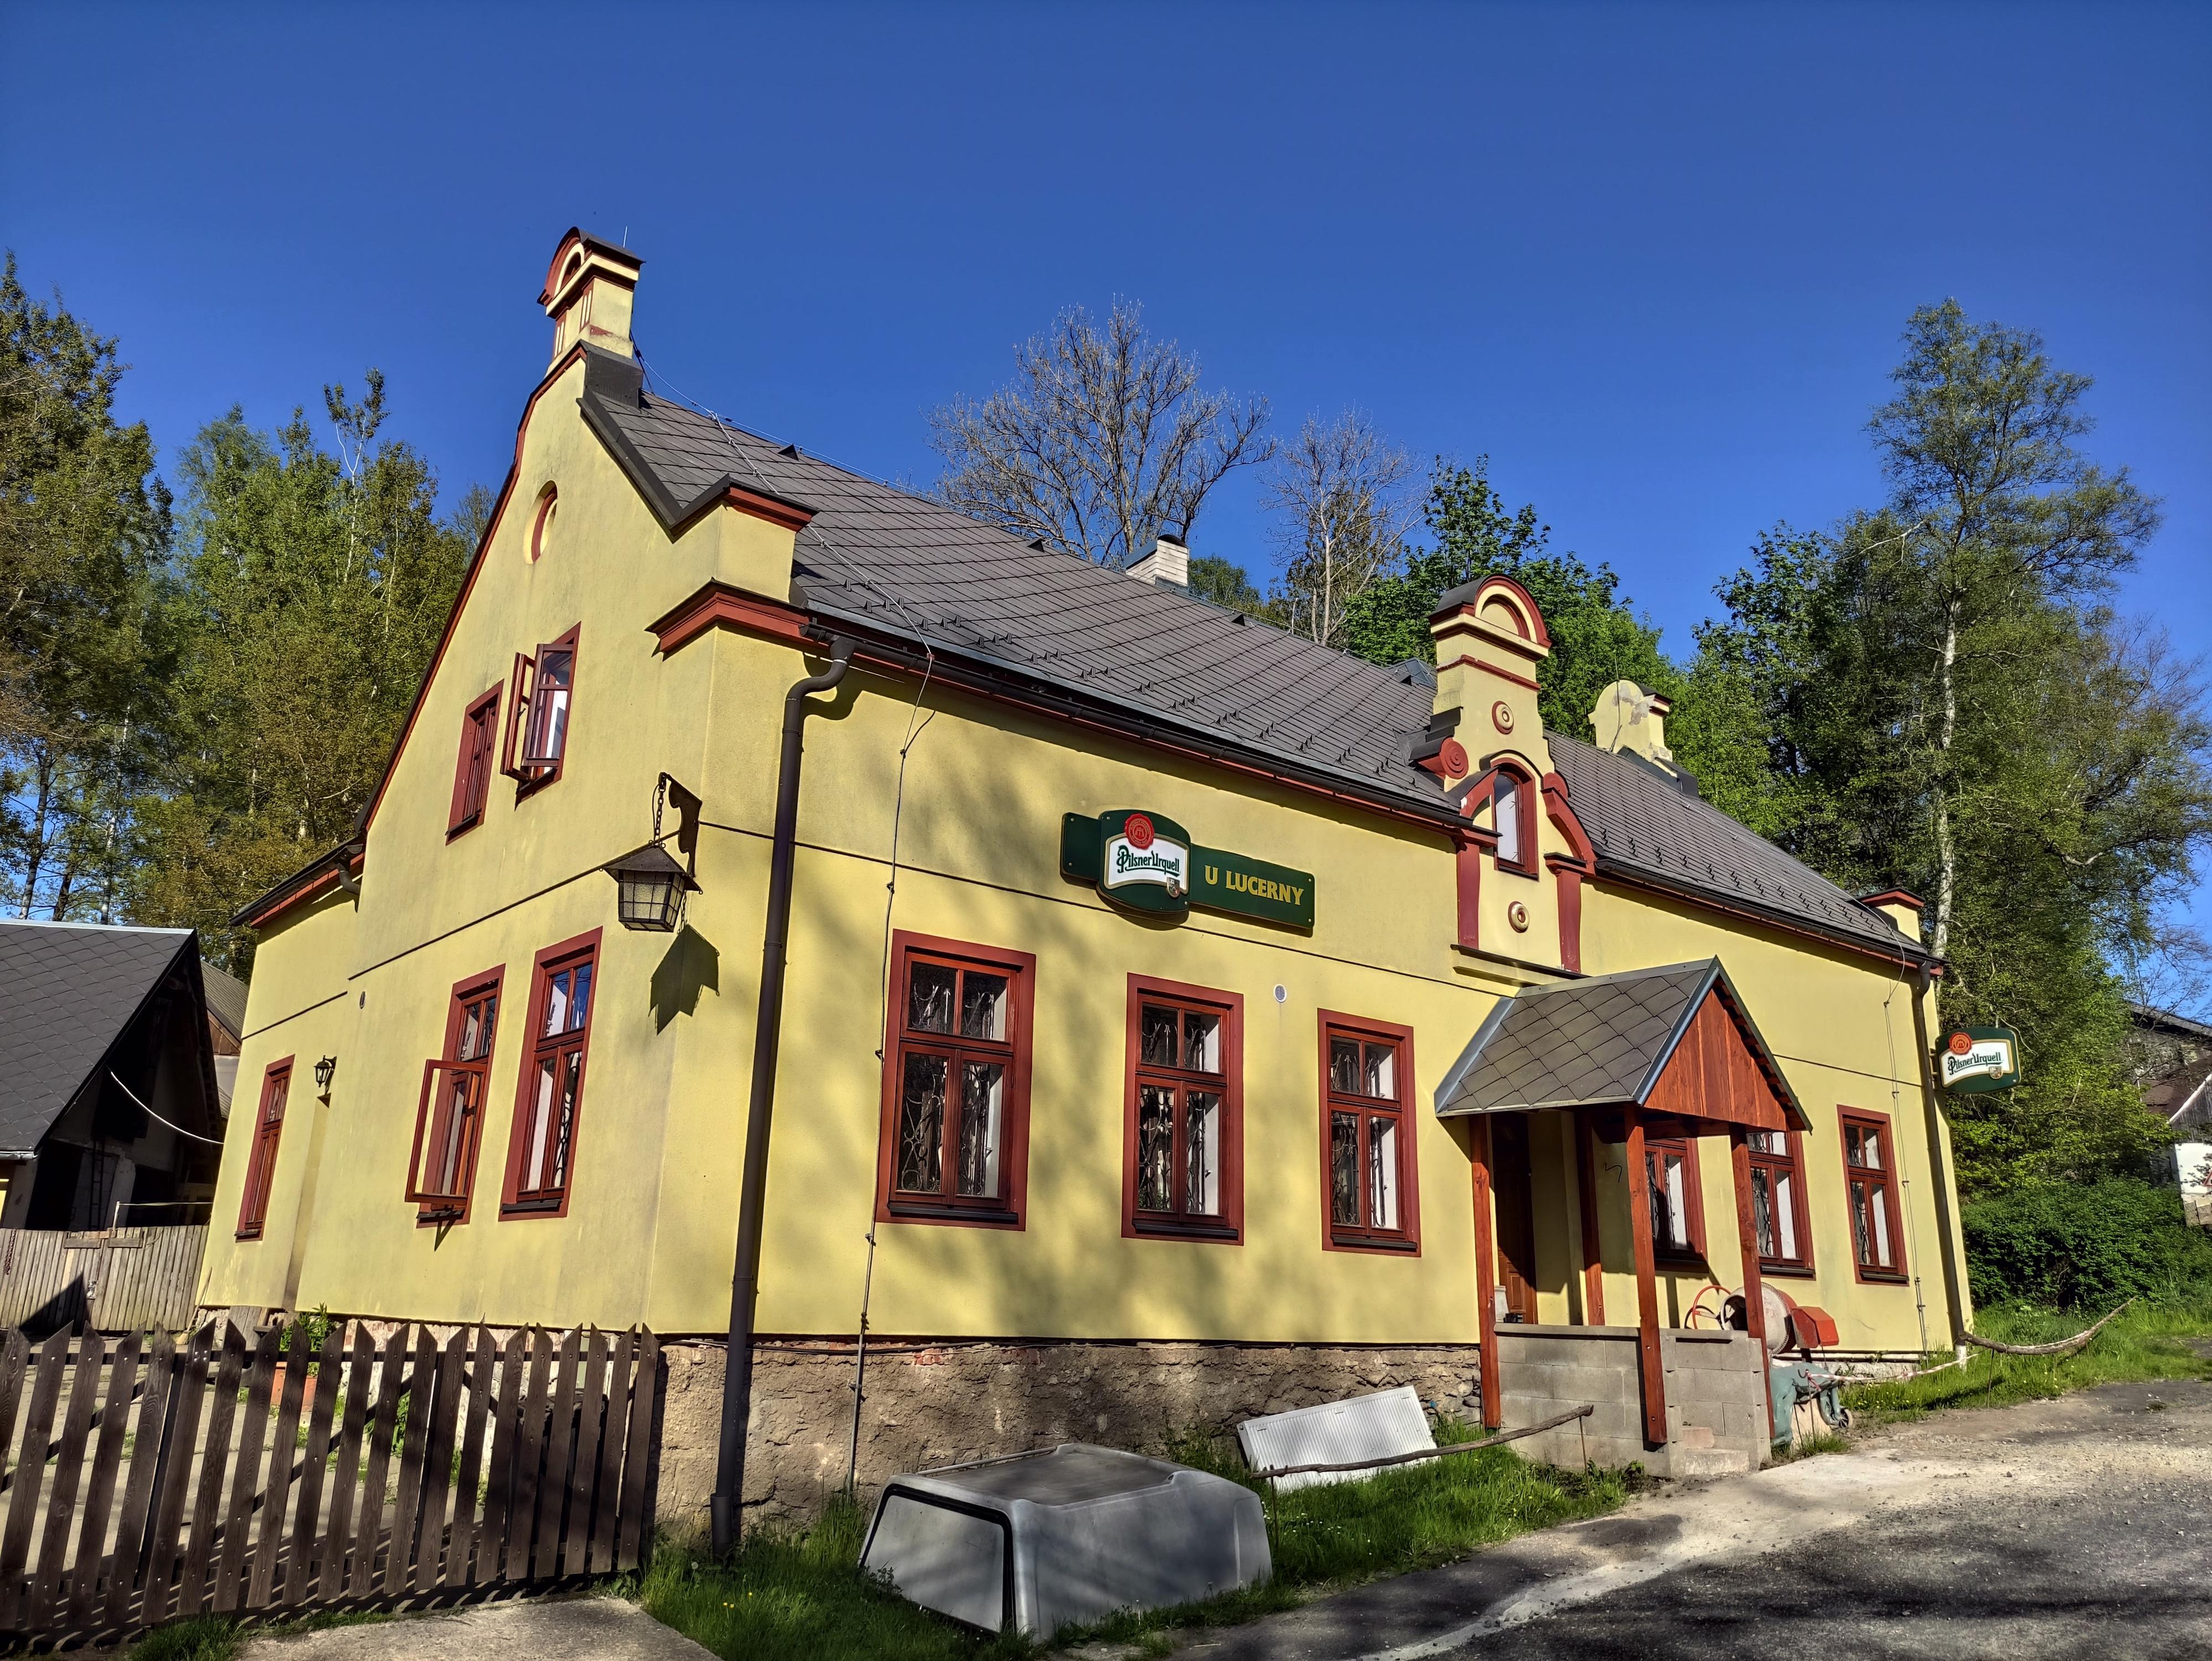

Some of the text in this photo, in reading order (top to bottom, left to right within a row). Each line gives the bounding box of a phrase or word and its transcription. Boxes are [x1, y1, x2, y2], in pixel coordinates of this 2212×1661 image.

[1116, 845, 1179, 875] Pilsner Urquell
[1205, 865, 1304, 905] U LUCERNY
[1947, 1052, 2001, 1075] Pilsner Urquell
